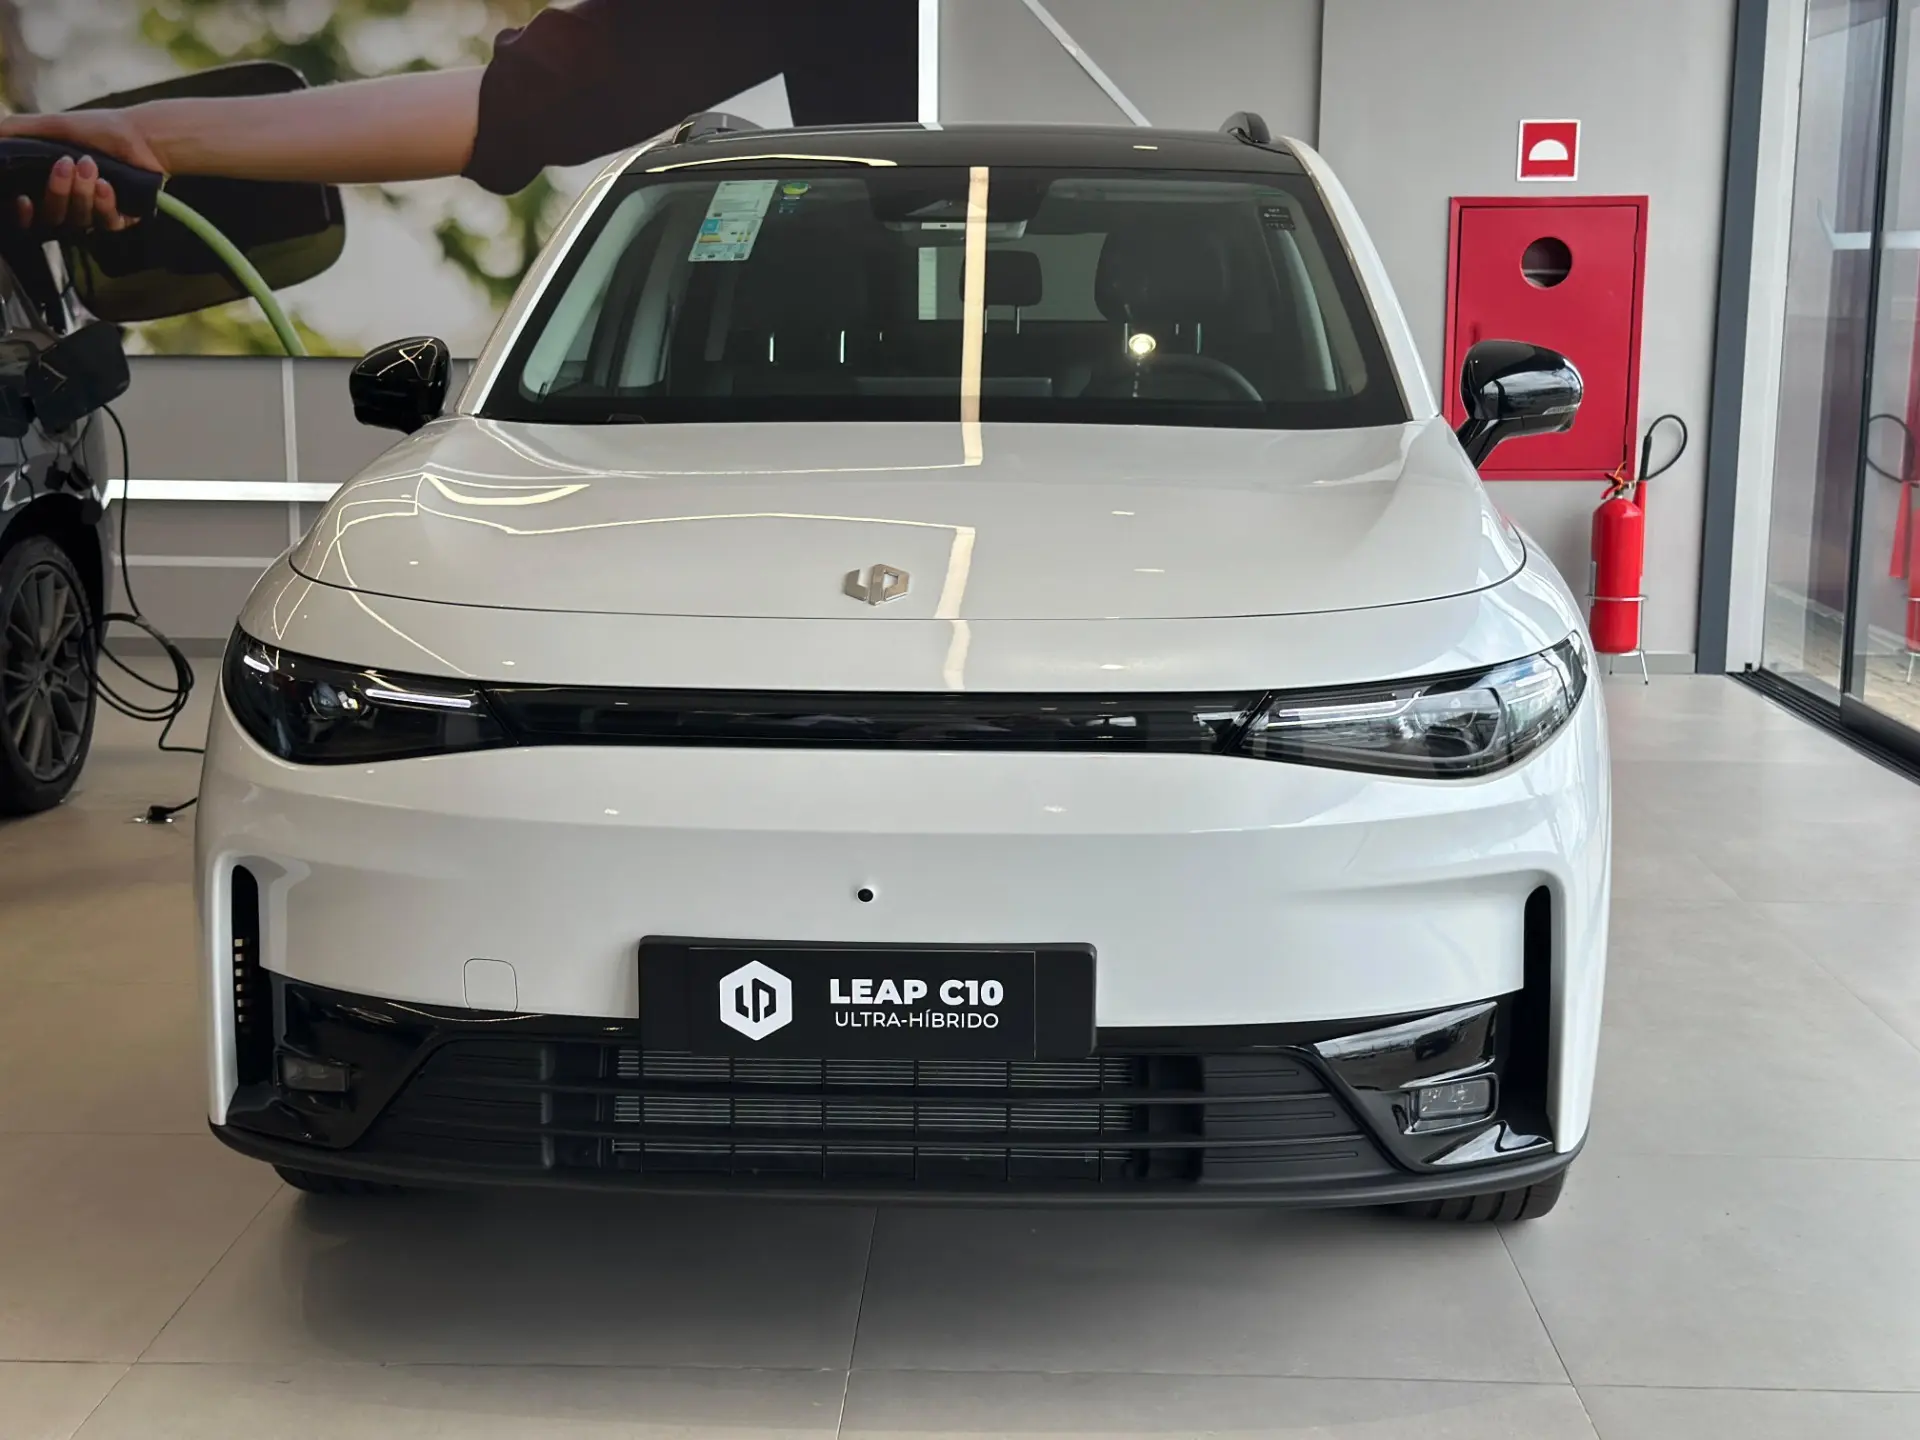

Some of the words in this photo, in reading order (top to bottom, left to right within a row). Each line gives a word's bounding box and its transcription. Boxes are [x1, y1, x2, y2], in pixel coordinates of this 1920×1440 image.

[829, 978, 928, 1005] LEAP
[939, 979, 1004, 1006] C10
[835, 1008, 999, 1028] ULTRA-HÍBRIDO
